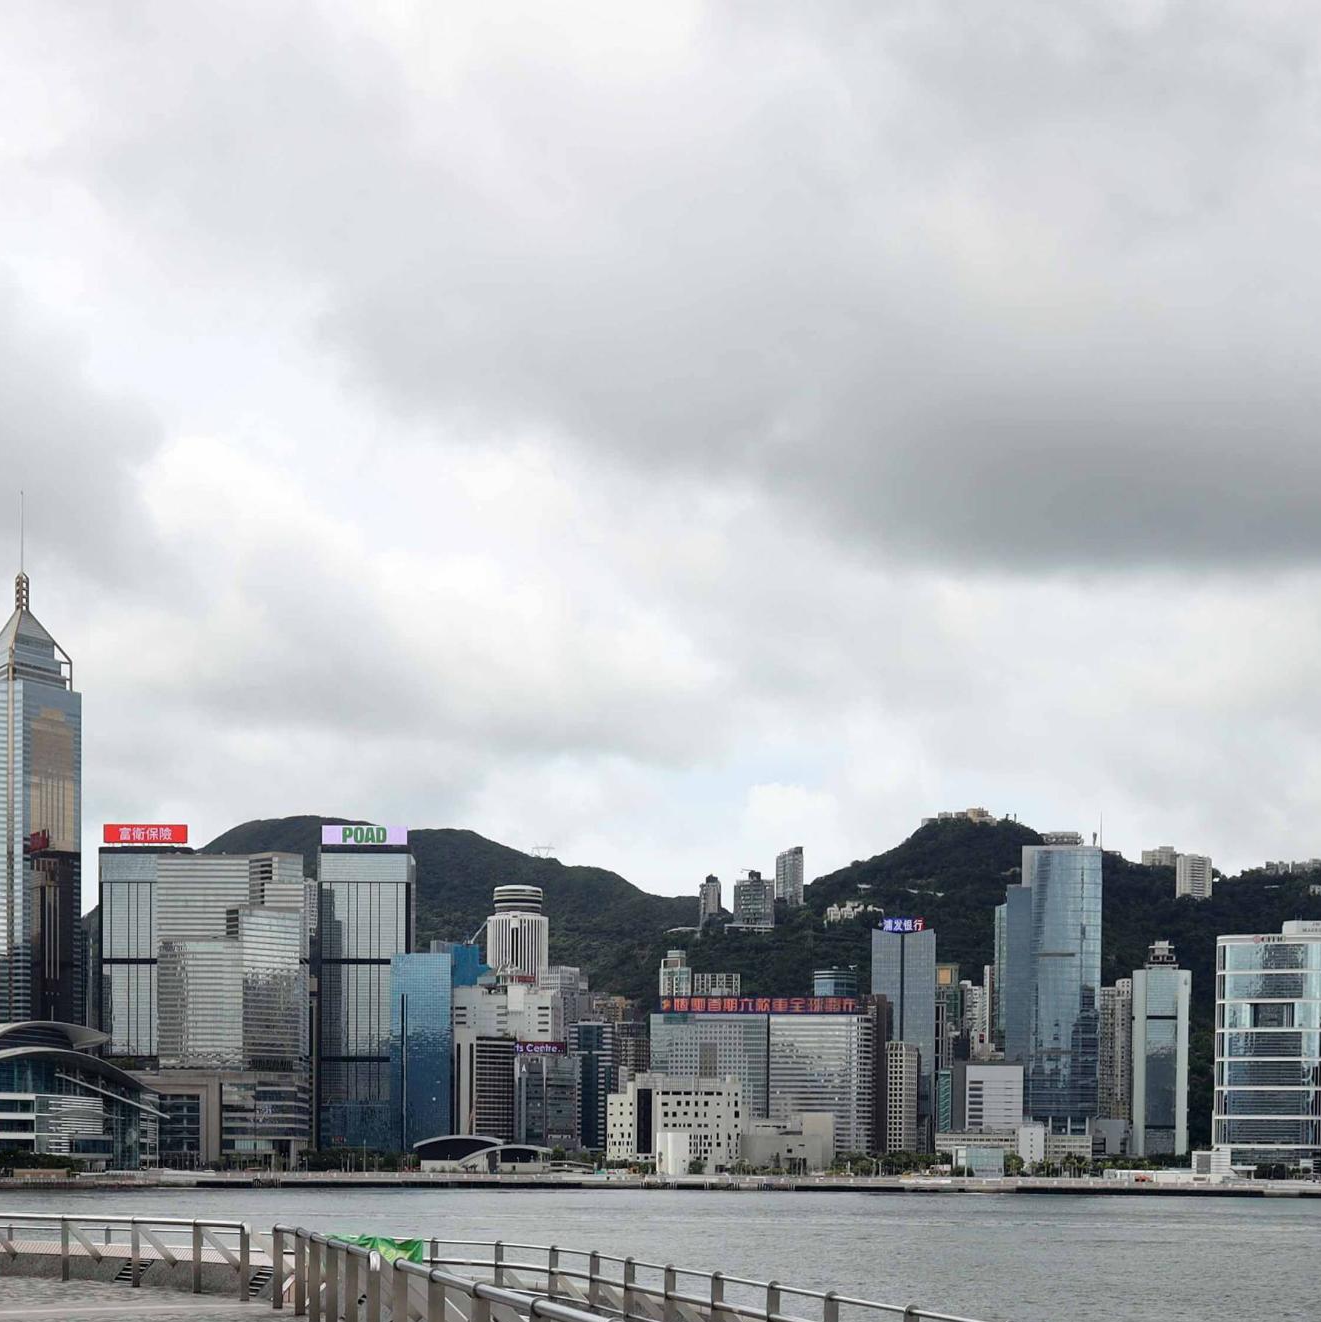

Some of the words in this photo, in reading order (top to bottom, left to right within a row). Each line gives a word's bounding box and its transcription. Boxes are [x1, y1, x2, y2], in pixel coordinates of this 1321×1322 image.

[119, 827, 172, 841] 富衛保險
[342, 827, 387, 843] POAD
[883, 919, 923, 931] 浦发银行
